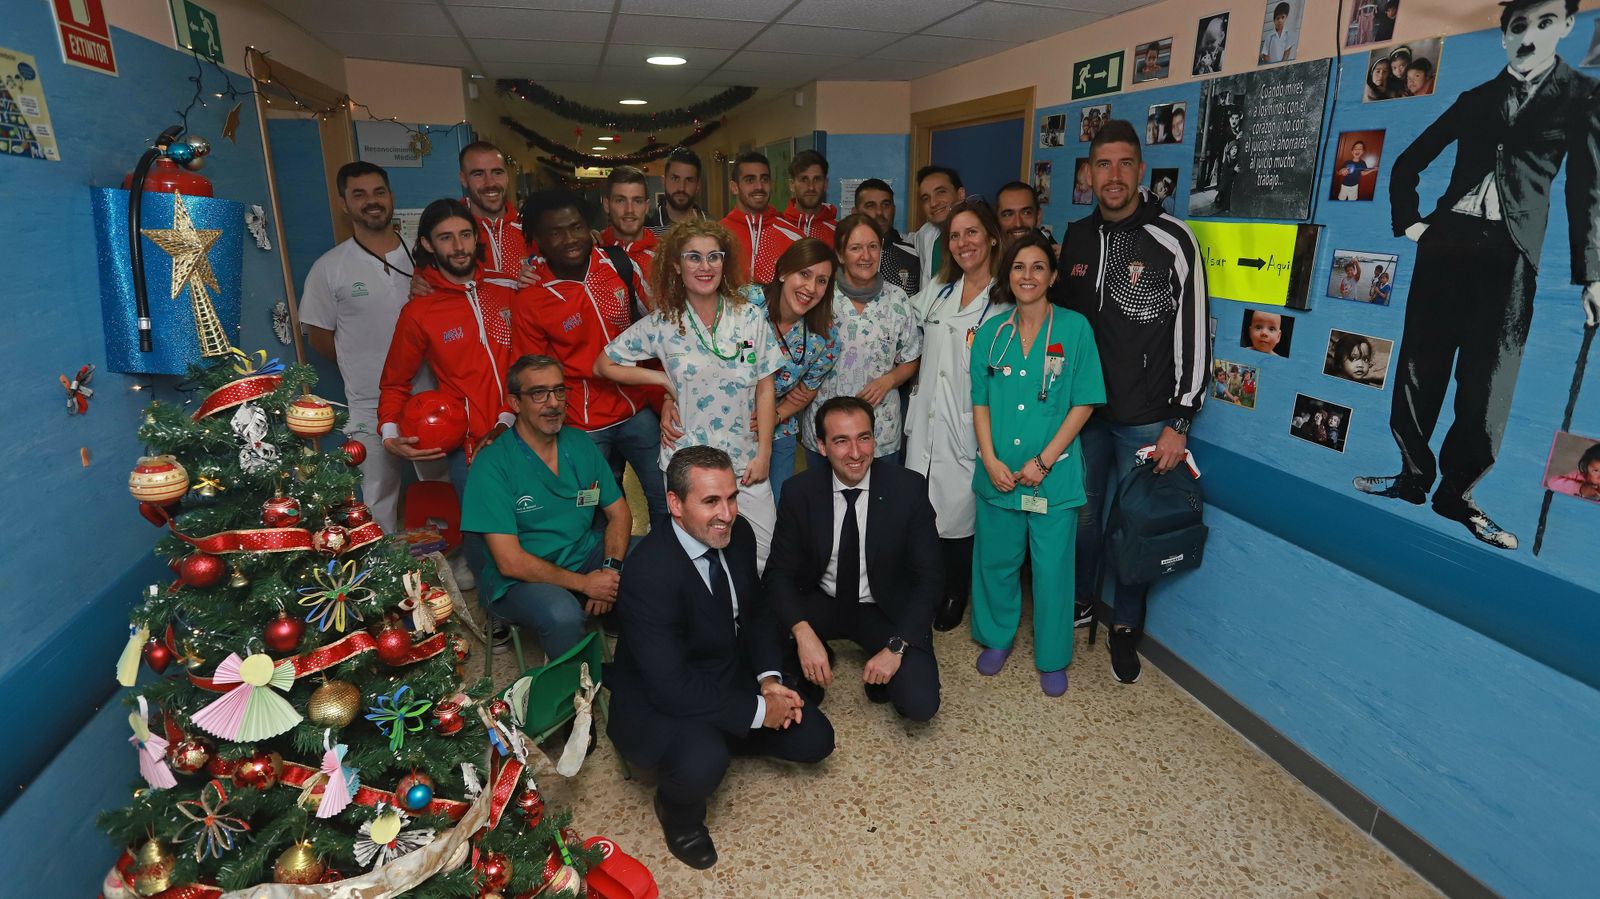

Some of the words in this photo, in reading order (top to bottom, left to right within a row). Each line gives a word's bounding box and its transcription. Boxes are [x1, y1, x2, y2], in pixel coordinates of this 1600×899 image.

[68, 33, 109, 64] EXTINTOR
[1261, 82, 1284, 99] Cuando
[1253, 106, 1258, 117] a
[1259, 102, 1268, 117] los
[1287, 100, 1299, 114] con
[1282, 120, 1291, 133] no
[1292, 118, 1304, 132] con
[1244, 136, 1251, 153] el
[1249, 153, 1256, 170] al
[1255, 154, 1273, 173] juicio
[1274, 151, 1296, 168] mucho
